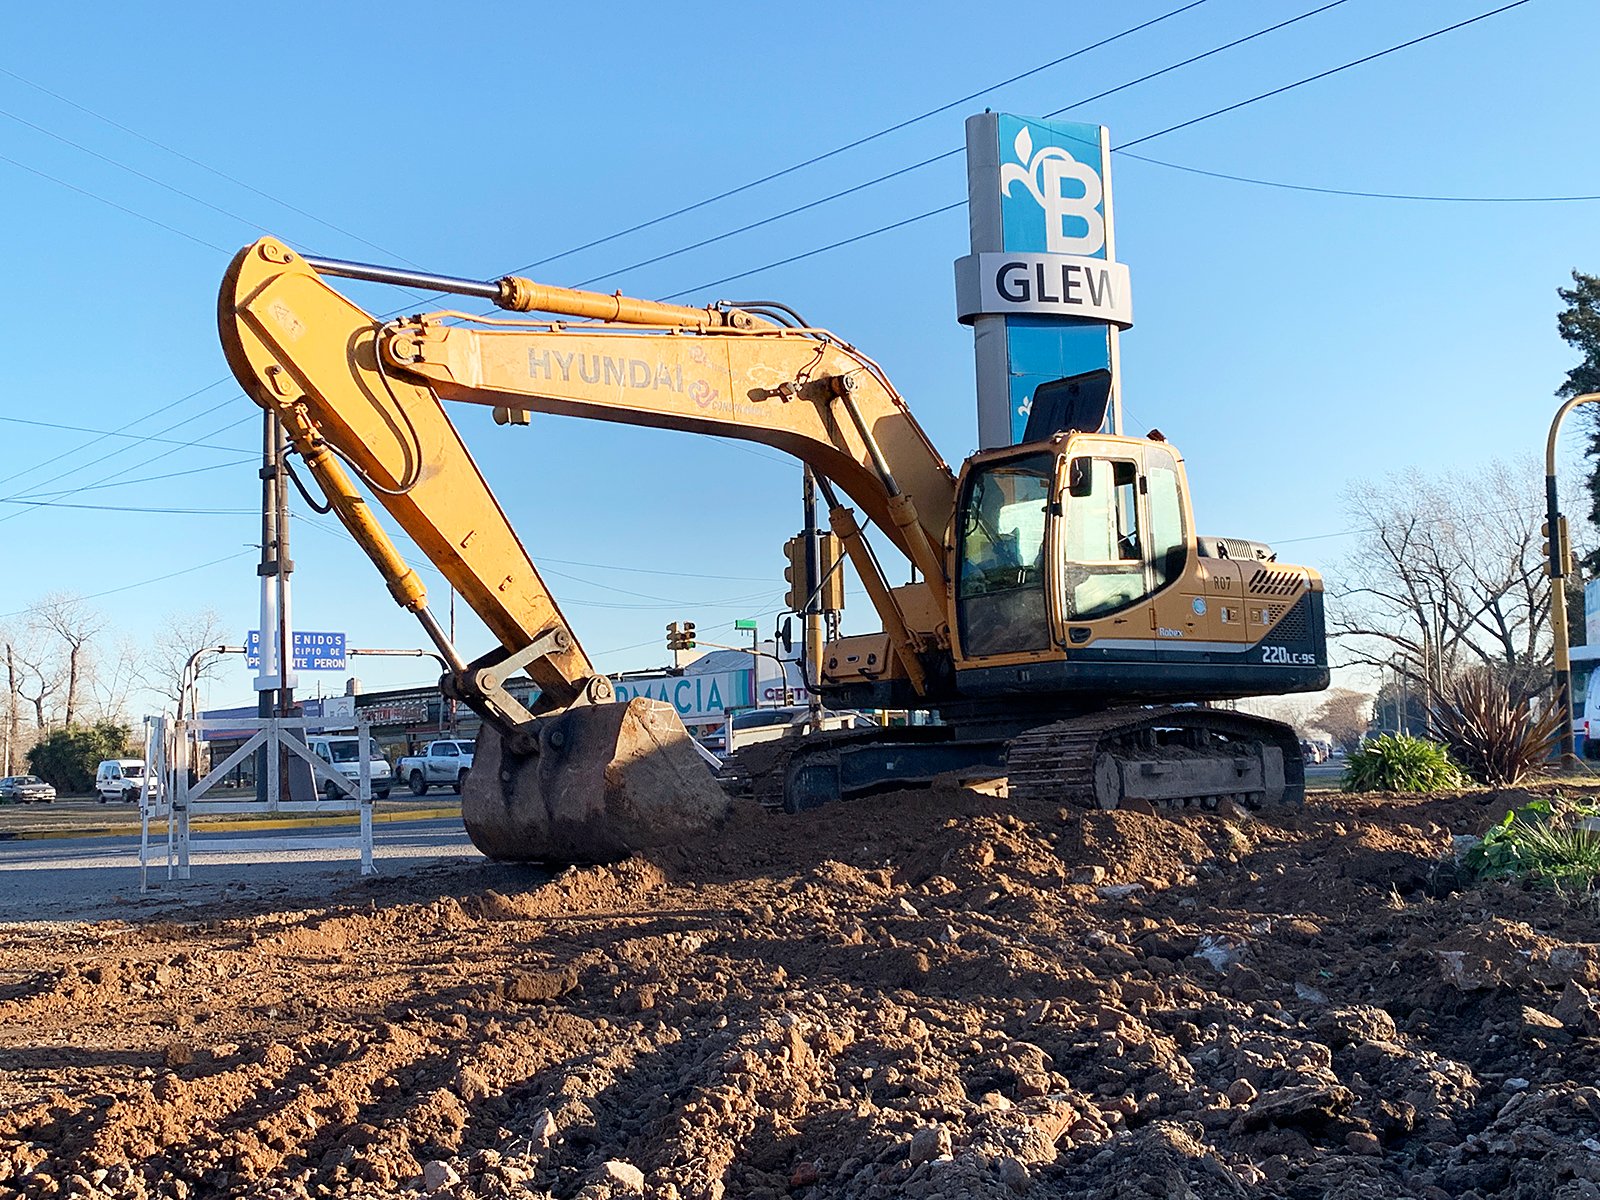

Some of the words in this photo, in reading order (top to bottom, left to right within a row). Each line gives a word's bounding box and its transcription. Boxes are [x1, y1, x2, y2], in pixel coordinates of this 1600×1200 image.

[994, 261, 1121, 310] GLEW
[527, 346, 684, 394] HYUNDAI
[1212, 575, 1232, 591] R07
[1158, 626, 1184, 638] Robex
[251, 633, 342, 645] BENIDOS
[330, 647, 340, 656] DE
[313, 658, 345, 668] PERON
